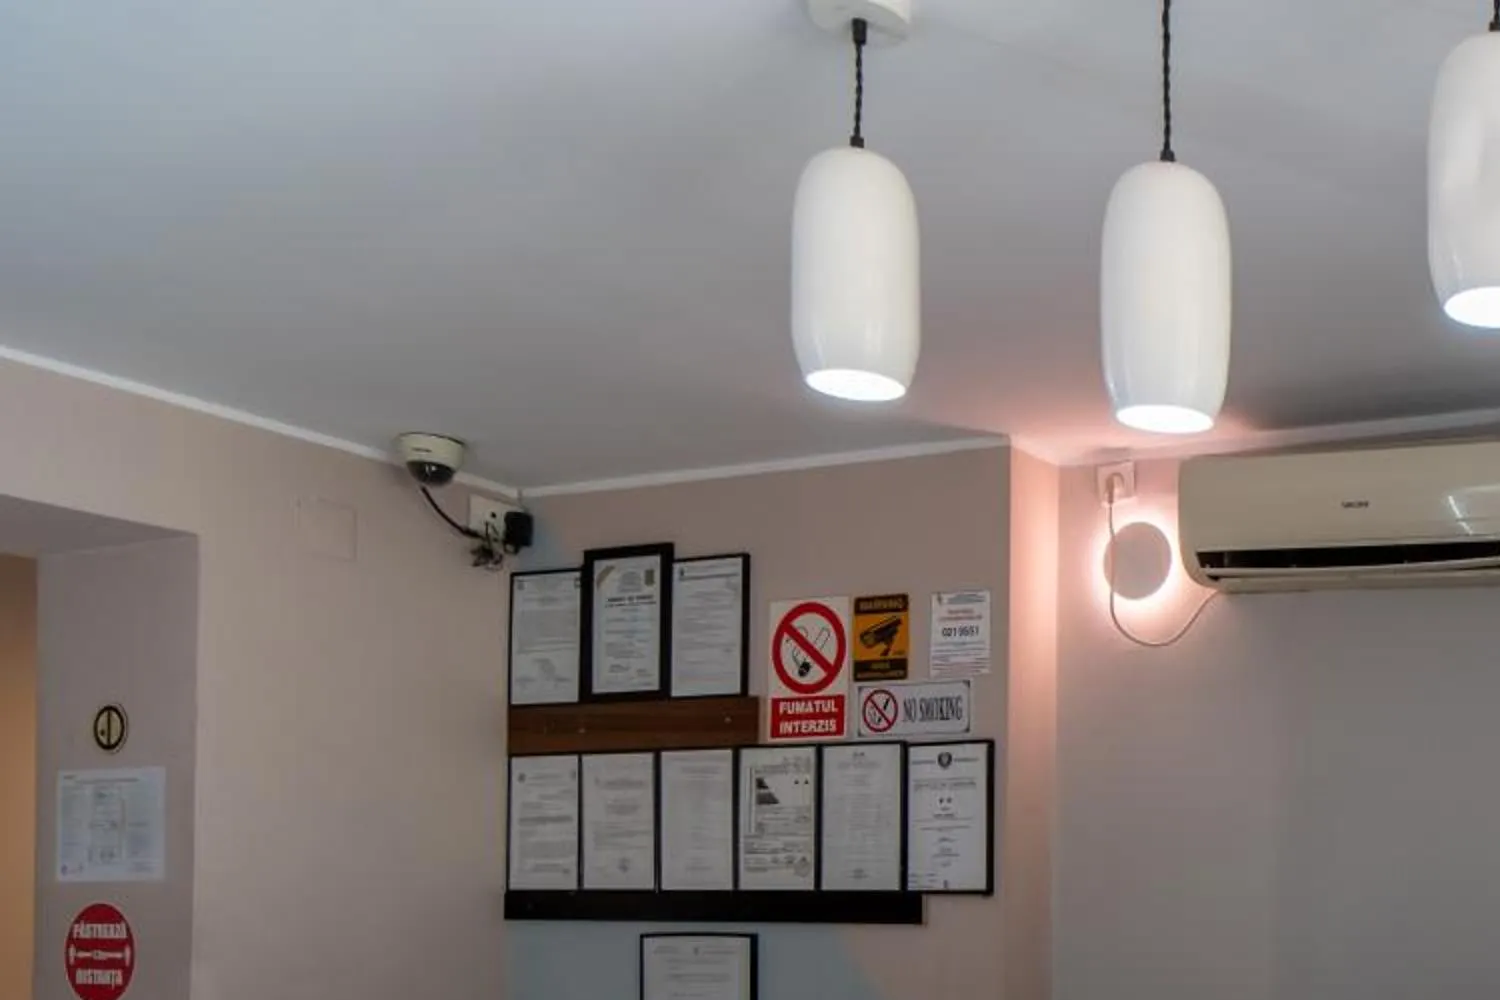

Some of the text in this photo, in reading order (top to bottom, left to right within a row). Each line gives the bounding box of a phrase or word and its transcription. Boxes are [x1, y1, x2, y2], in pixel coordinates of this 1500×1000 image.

[779, 700, 838, 714] FUMATUL
[903, 696, 963, 722] NO SMOKING
[779, 719, 837, 734] INTERZIS
